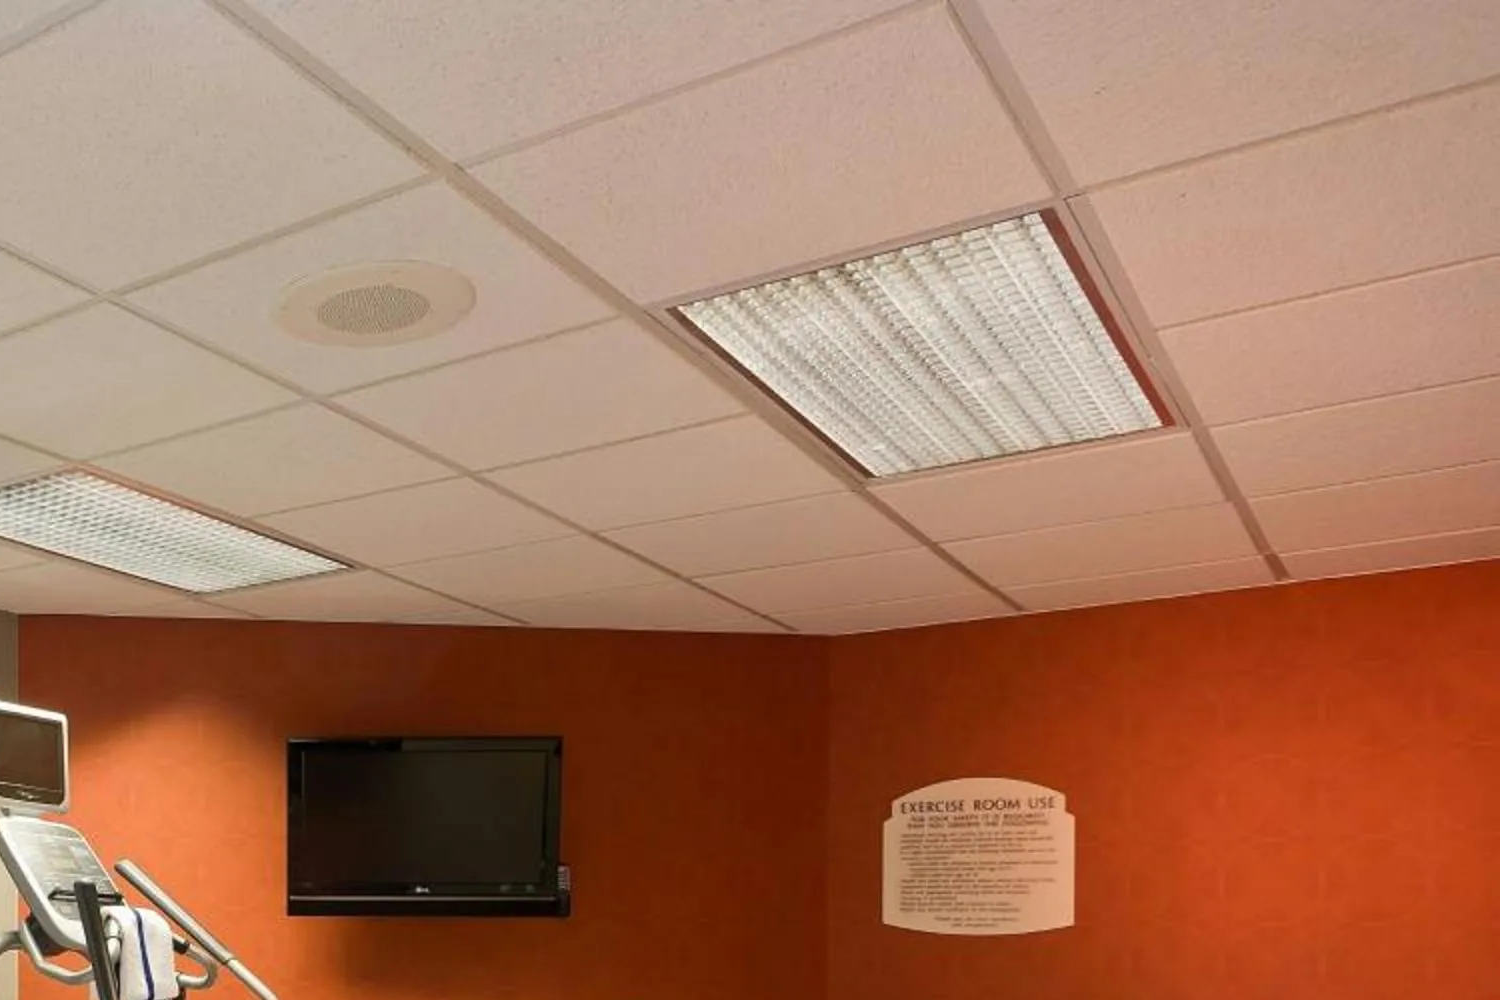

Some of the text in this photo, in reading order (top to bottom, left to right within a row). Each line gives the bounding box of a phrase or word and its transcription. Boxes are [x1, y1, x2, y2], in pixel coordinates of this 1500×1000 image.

[900, 795, 1056, 815] EXERCISE ROOM USE
